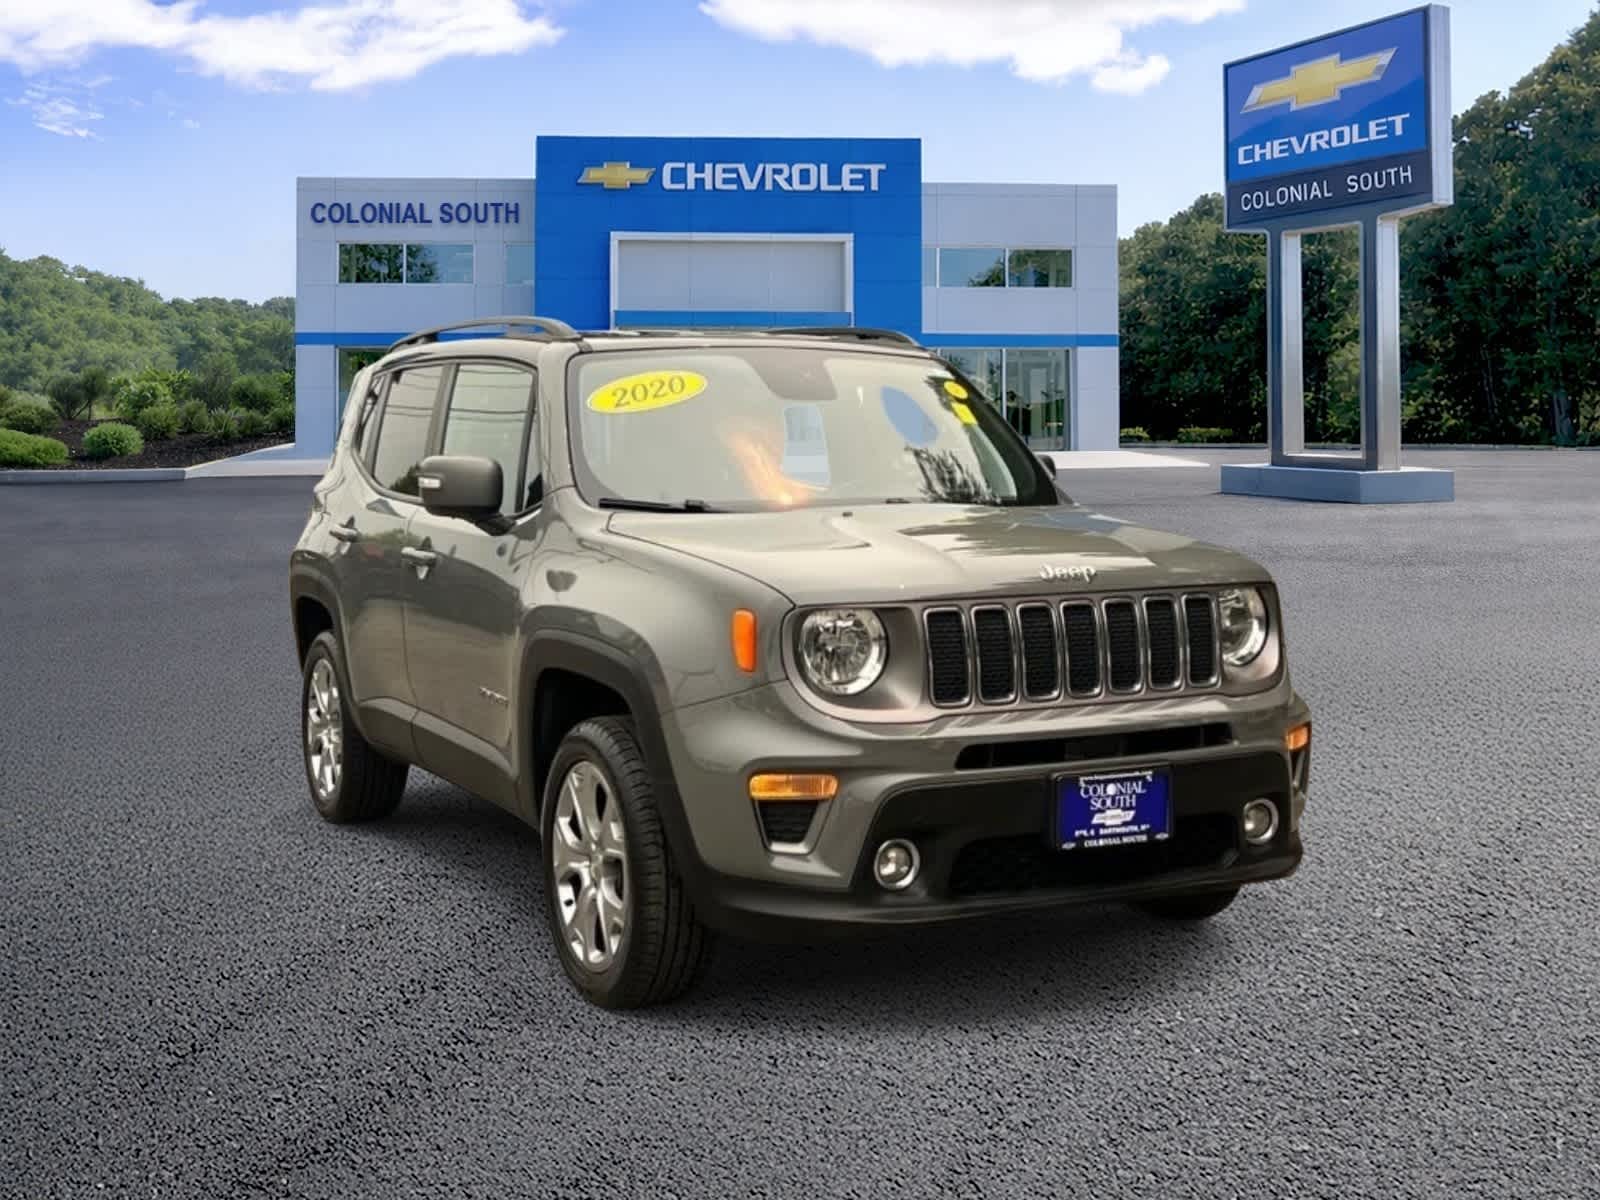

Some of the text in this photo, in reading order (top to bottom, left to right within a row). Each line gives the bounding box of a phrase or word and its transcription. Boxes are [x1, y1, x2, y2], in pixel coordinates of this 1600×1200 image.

[1238, 113, 1410, 165] CHEVROLET
[662, 161, 886, 191] CHEVROLET
[1241, 165, 1412, 211] COLONIAL SOUTH
[310, 202, 519, 224] COLONIAL SOUTH
[611, 375, 685, 408] 2020
[1040, 563, 1096, 582] Jeep
[1080, 781, 1146, 798] COLONIAL
[1090, 794, 1136, 810] SOUTH
